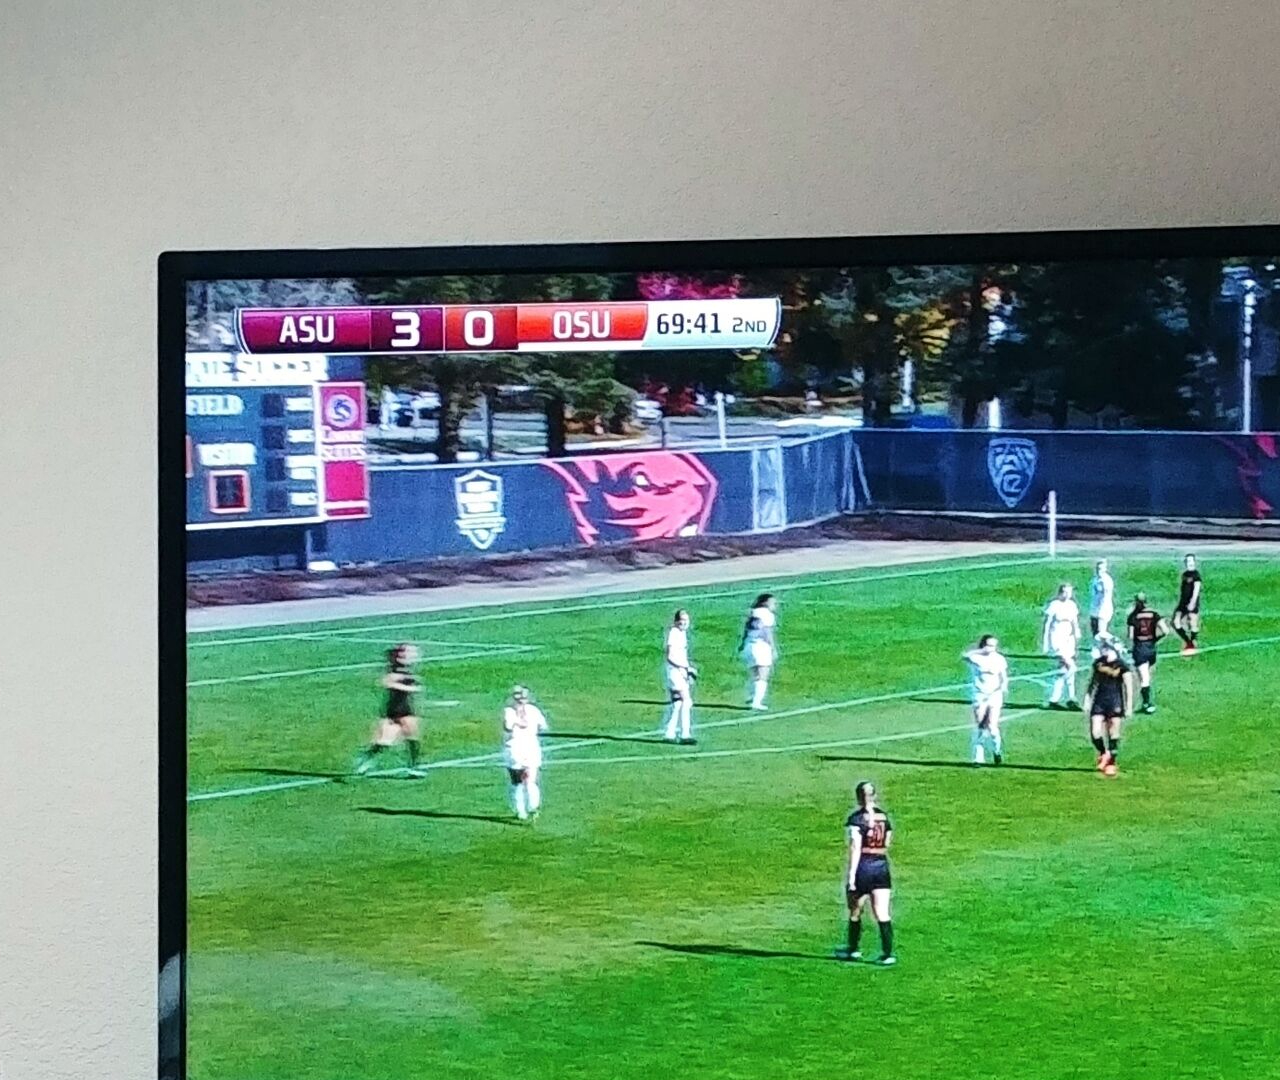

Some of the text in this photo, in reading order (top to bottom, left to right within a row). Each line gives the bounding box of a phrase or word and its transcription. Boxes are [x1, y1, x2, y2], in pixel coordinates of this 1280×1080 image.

[278, 310, 767, 348] ASU 3 0 OSU 69:41 2ND
